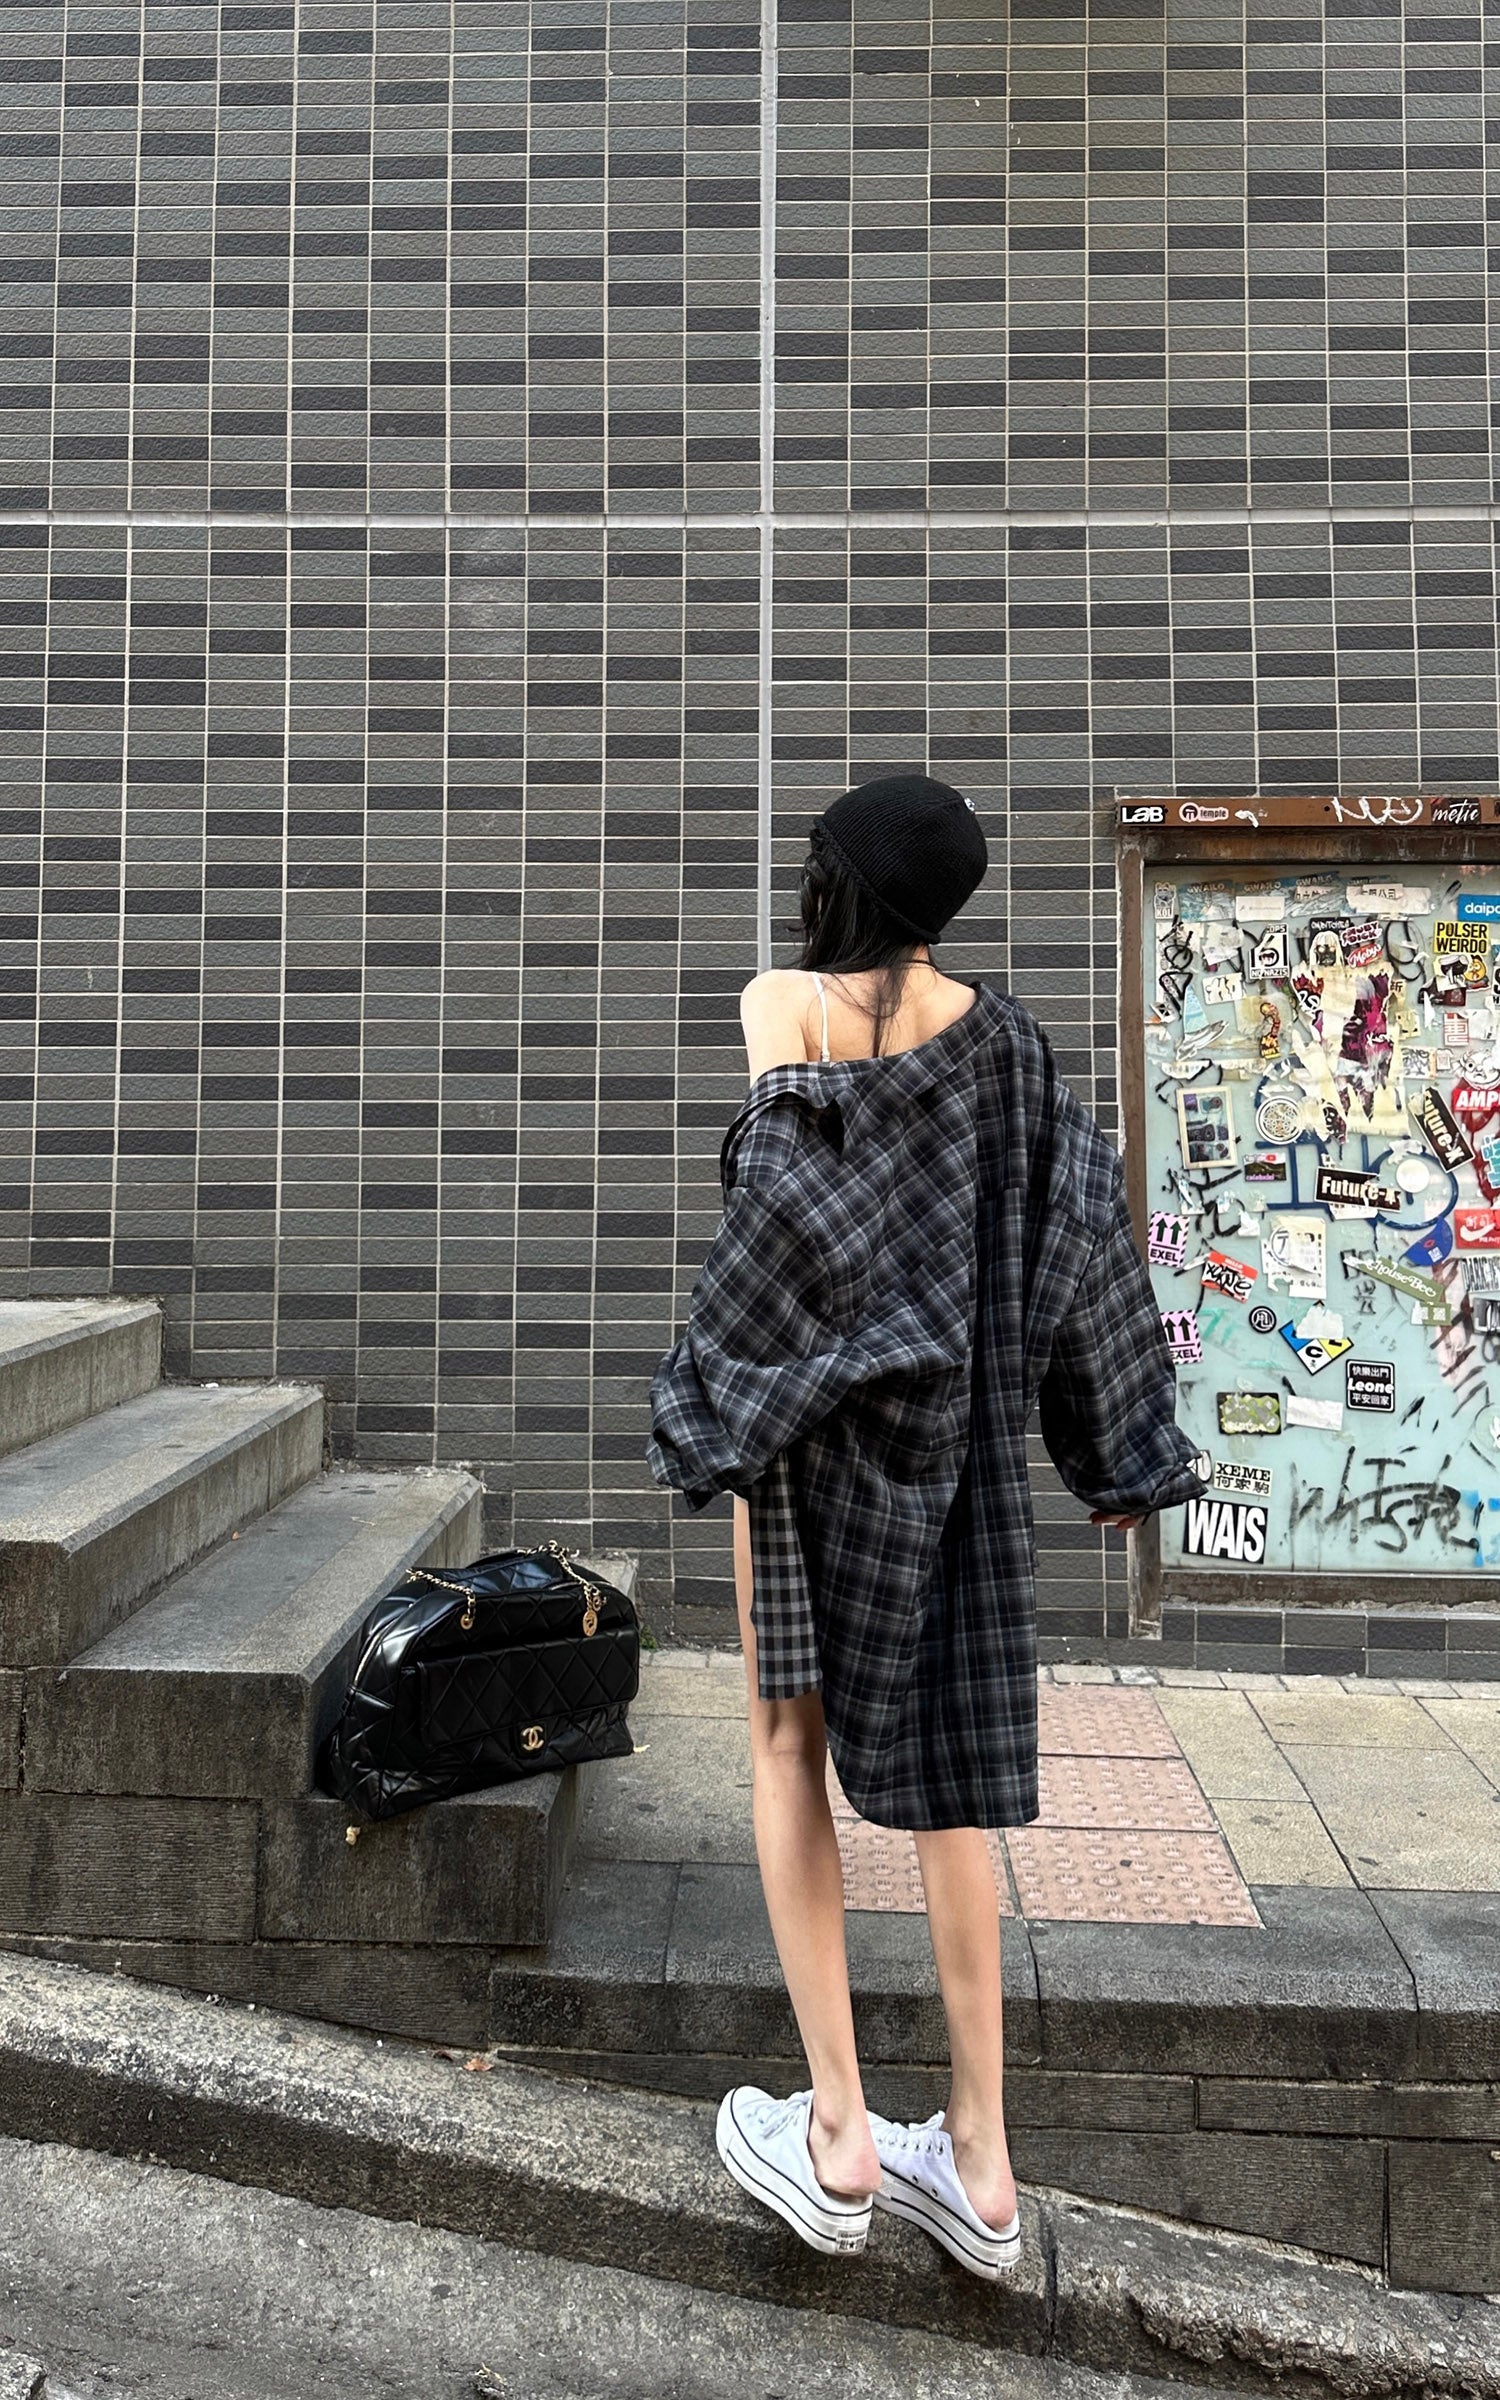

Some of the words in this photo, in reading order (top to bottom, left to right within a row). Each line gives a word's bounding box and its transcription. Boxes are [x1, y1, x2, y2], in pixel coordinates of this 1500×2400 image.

[1437, 922, 1488, 939] POLSER
[1436, 938, 1487, 953] WEIRDO
[1150, 1249, 1178, 1263] EXEL
[1348, 1377, 1394, 1394] Leone
[1216, 1462, 1271, 1482] XEME
[1188, 1499, 1266, 1562] WAIS
